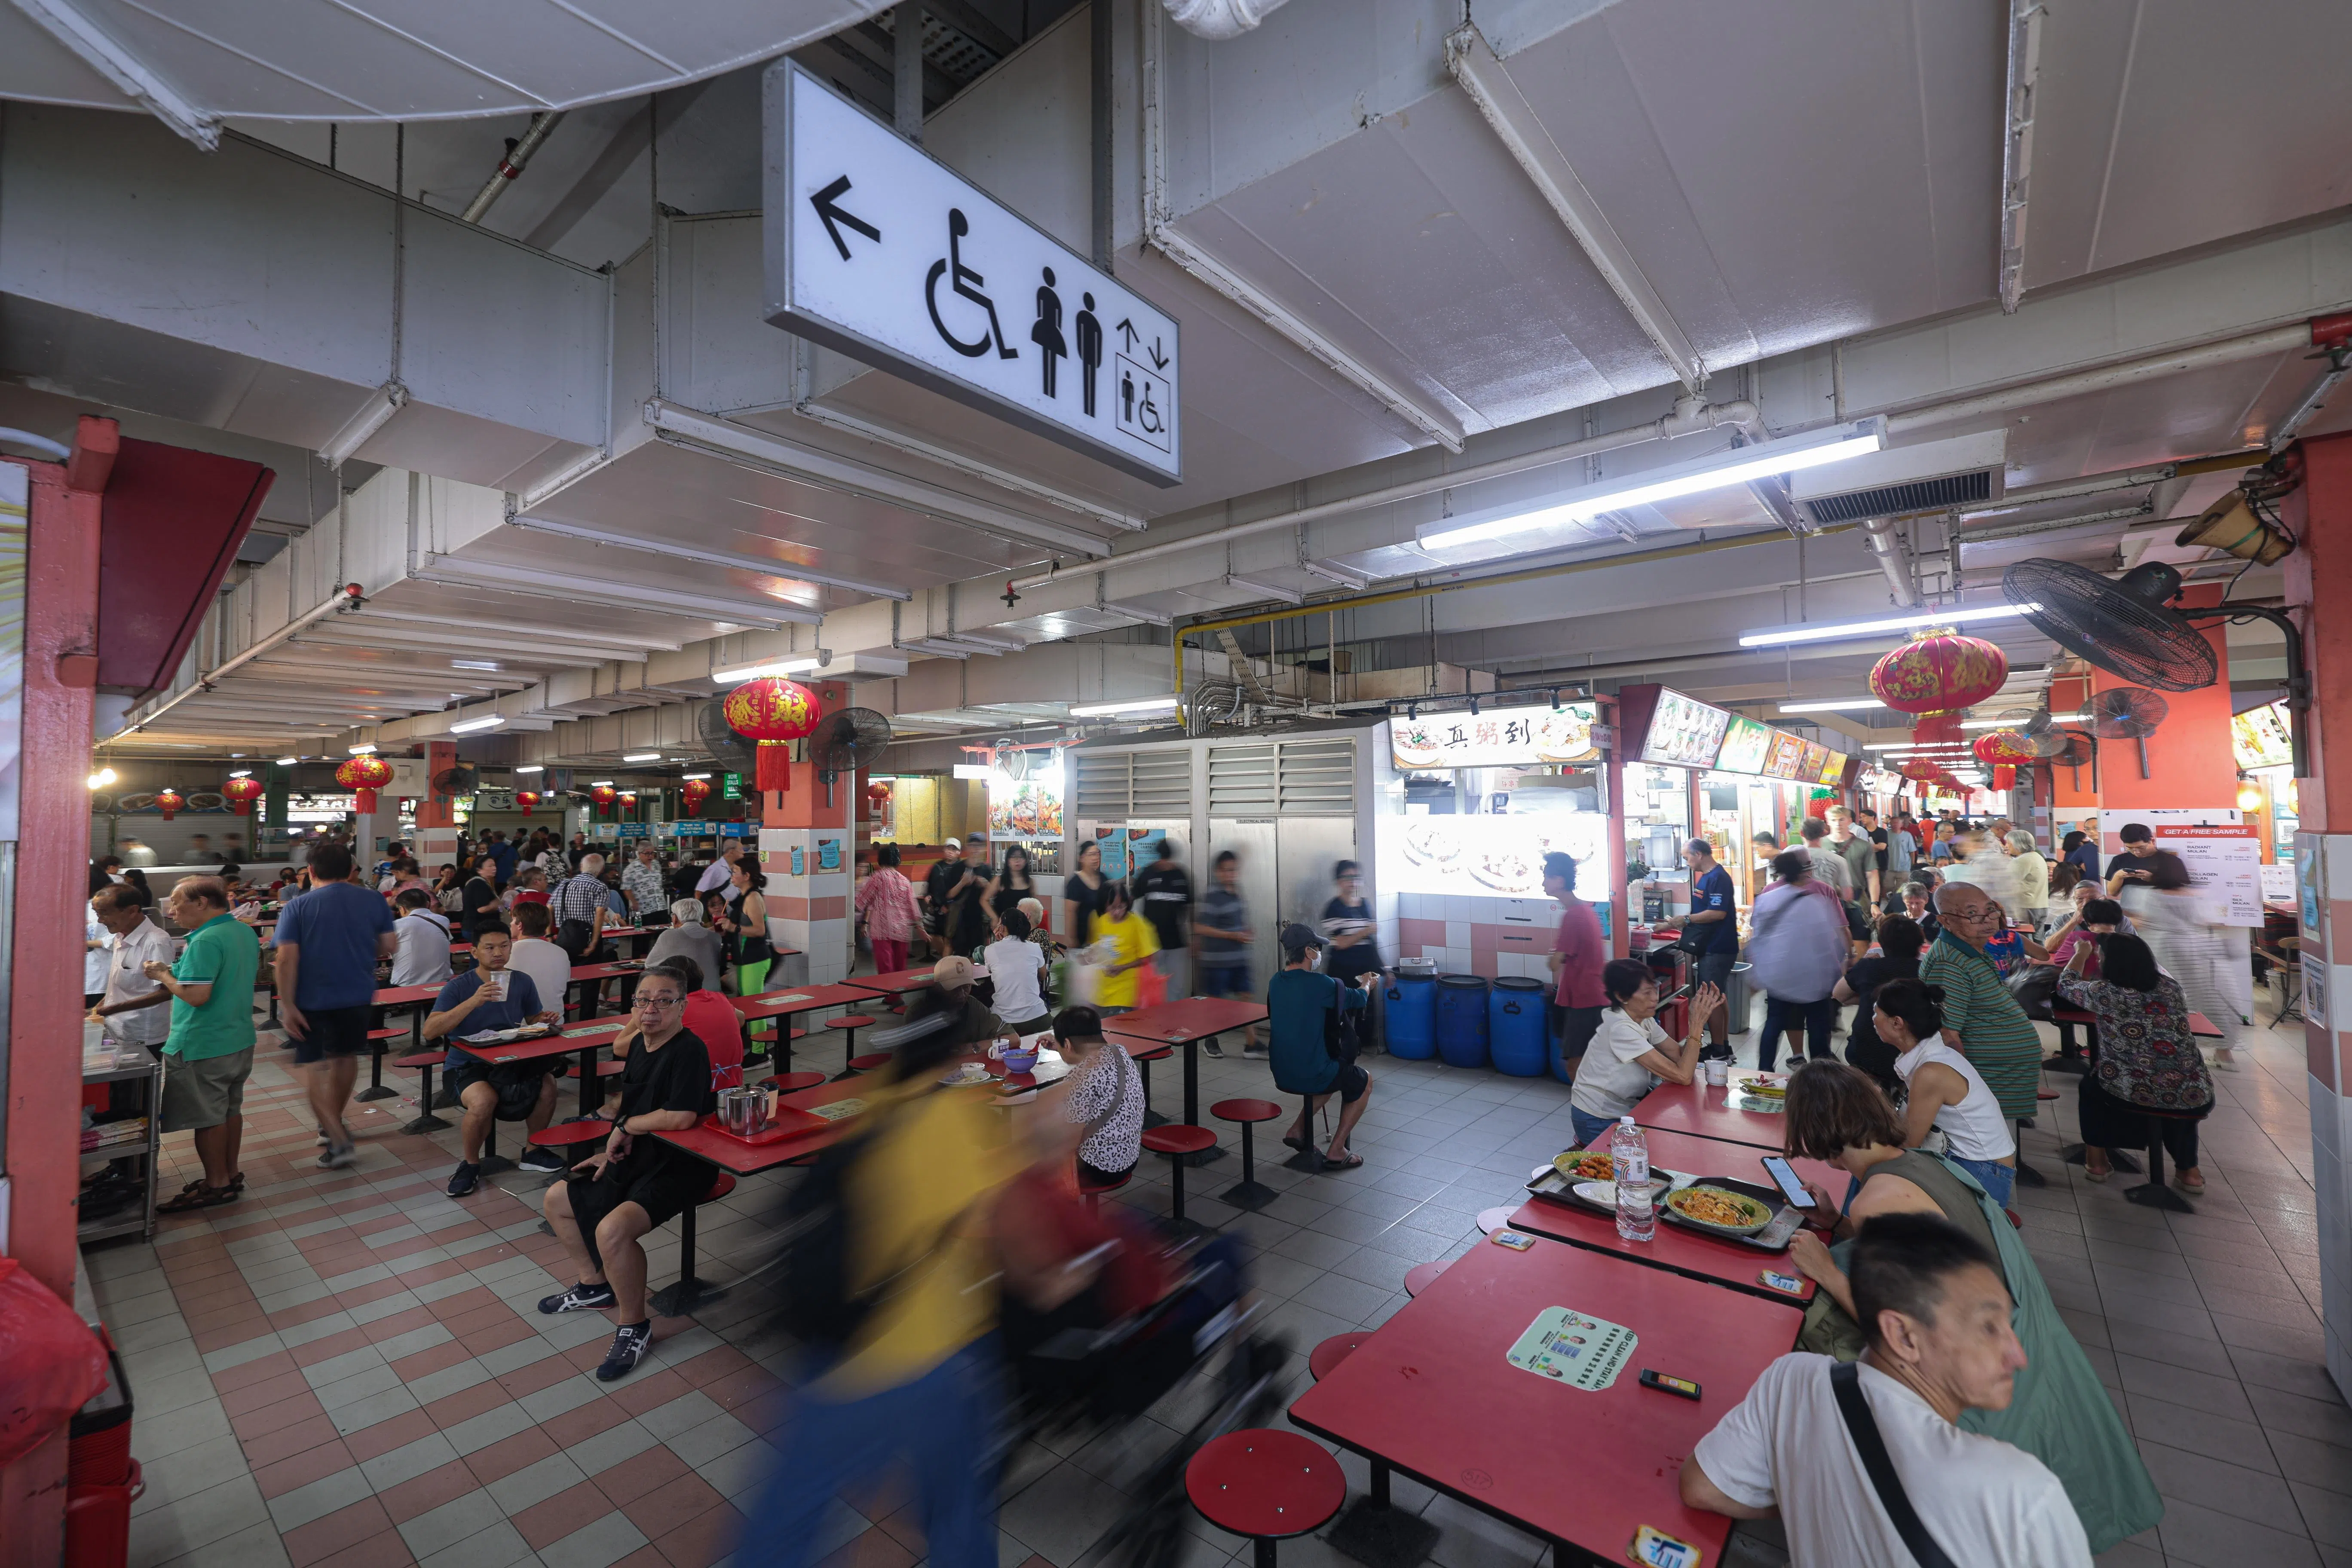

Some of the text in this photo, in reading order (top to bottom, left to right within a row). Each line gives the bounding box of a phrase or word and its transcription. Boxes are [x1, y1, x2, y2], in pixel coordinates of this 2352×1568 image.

[1444, 718, 1531, 748] 真粥到
[955, 962, 964, 974] C
[1624, 1330, 1635, 1342] KEEP
[1614, 1341, 1629, 1357] CLEAN
[1607, 1356, 1619, 1367] AND
[1599, 1367, 1613, 1380] STAY
